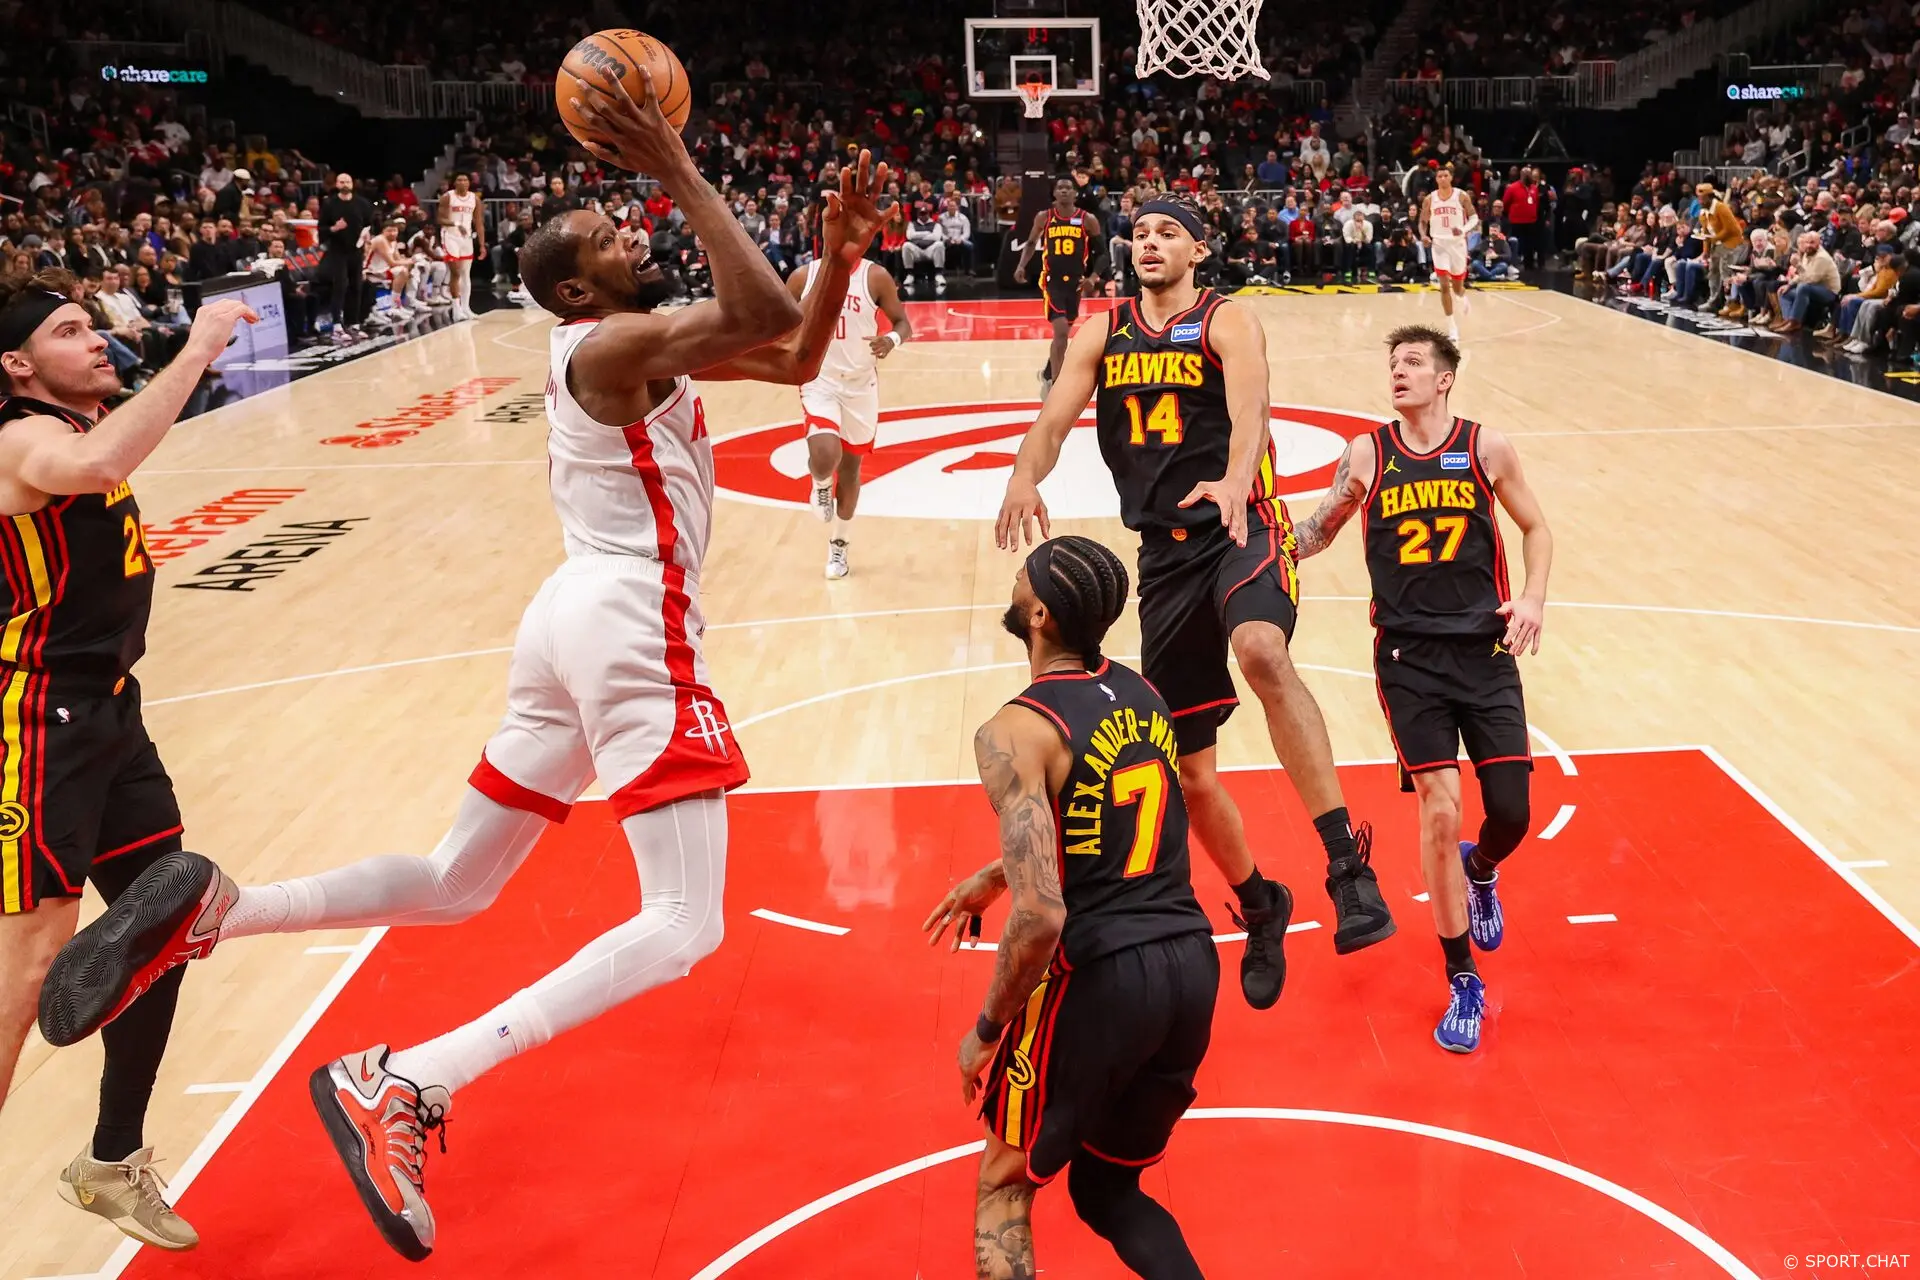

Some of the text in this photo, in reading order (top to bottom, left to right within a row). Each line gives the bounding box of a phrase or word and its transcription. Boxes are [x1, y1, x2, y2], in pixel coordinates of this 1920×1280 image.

[120, 65, 208, 83] sharecare
[1048, 226, 1081, 238] HAWKS
[1054, 239, 1074, 255] 18
[1174, 327, 1199, 338] paze
[1104, 351, 1204, 389] HAWKS
[1123, 392, 1184, 446] 14
[1443, 458, 1467, 466] paze
[1380, 479, 1476, 519] HAWKS
[171, 516, 371, 592] ARENA
[1396, 515, 1469, 565] 27
[1065, 706, 1181, 856] ALEXANDER-WAL
[1112, 758, 1169, 879] 7
